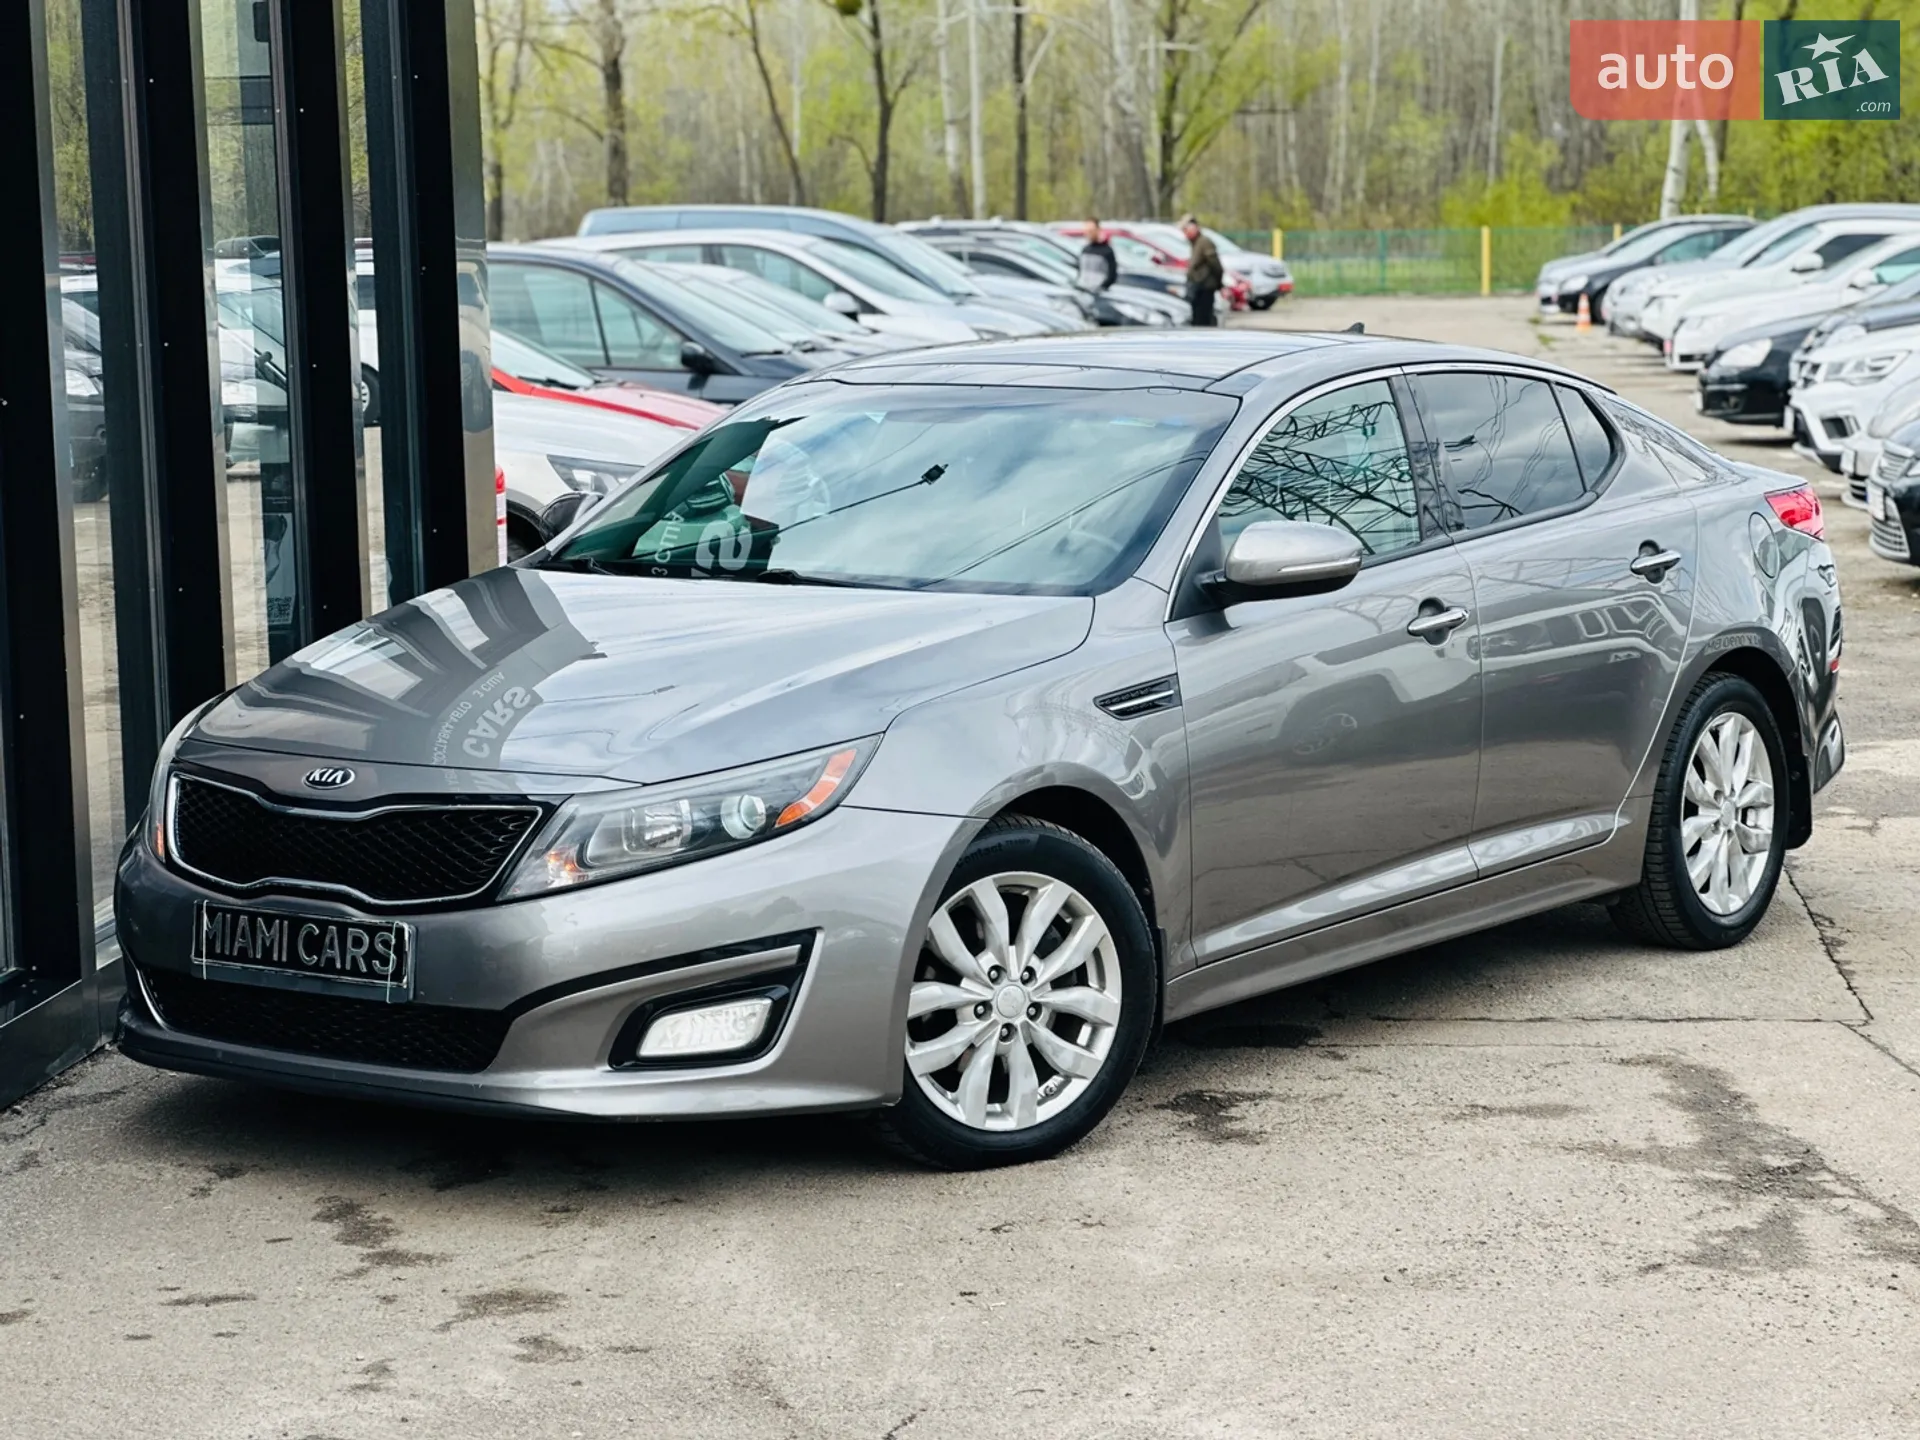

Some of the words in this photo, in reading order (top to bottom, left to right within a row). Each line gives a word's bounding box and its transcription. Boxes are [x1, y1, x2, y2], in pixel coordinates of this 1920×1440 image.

[308, 767, 346, 784] KIA
[199, 909, 289, 963] MIAMI
[297, 922, 398, 975] CARS
